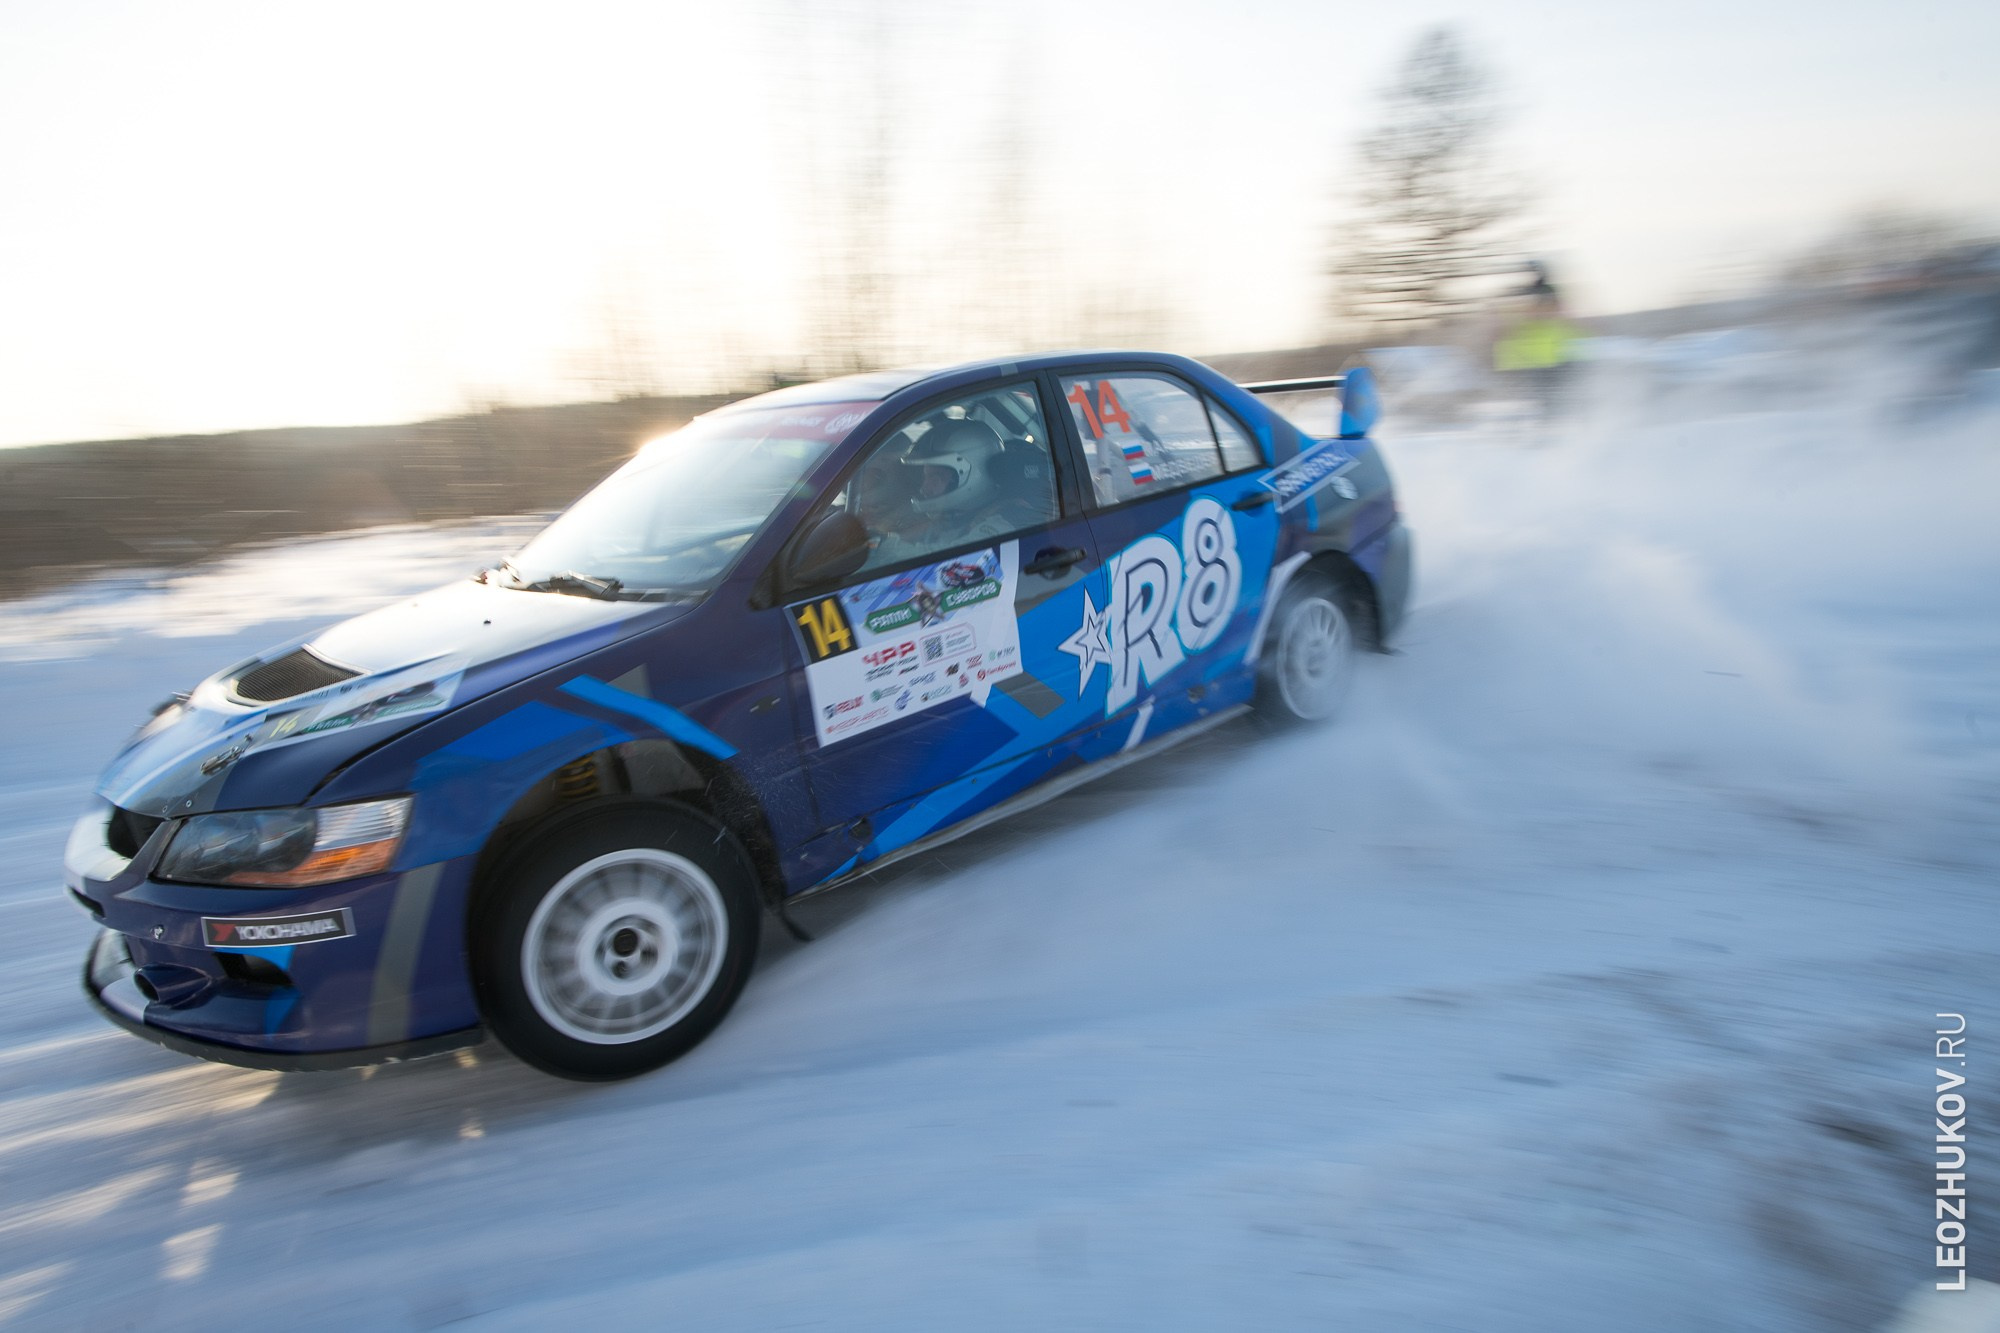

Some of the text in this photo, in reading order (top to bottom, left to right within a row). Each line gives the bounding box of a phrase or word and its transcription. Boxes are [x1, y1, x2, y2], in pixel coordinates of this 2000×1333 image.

[1068, 380, 1131, 439] 14
[797, 598, 852, 658] 14
[1106, 495, 1242, 719] R8
[268, 715, 298, 738] 14
[235, 917, 341, 940] YOKOHAMA
